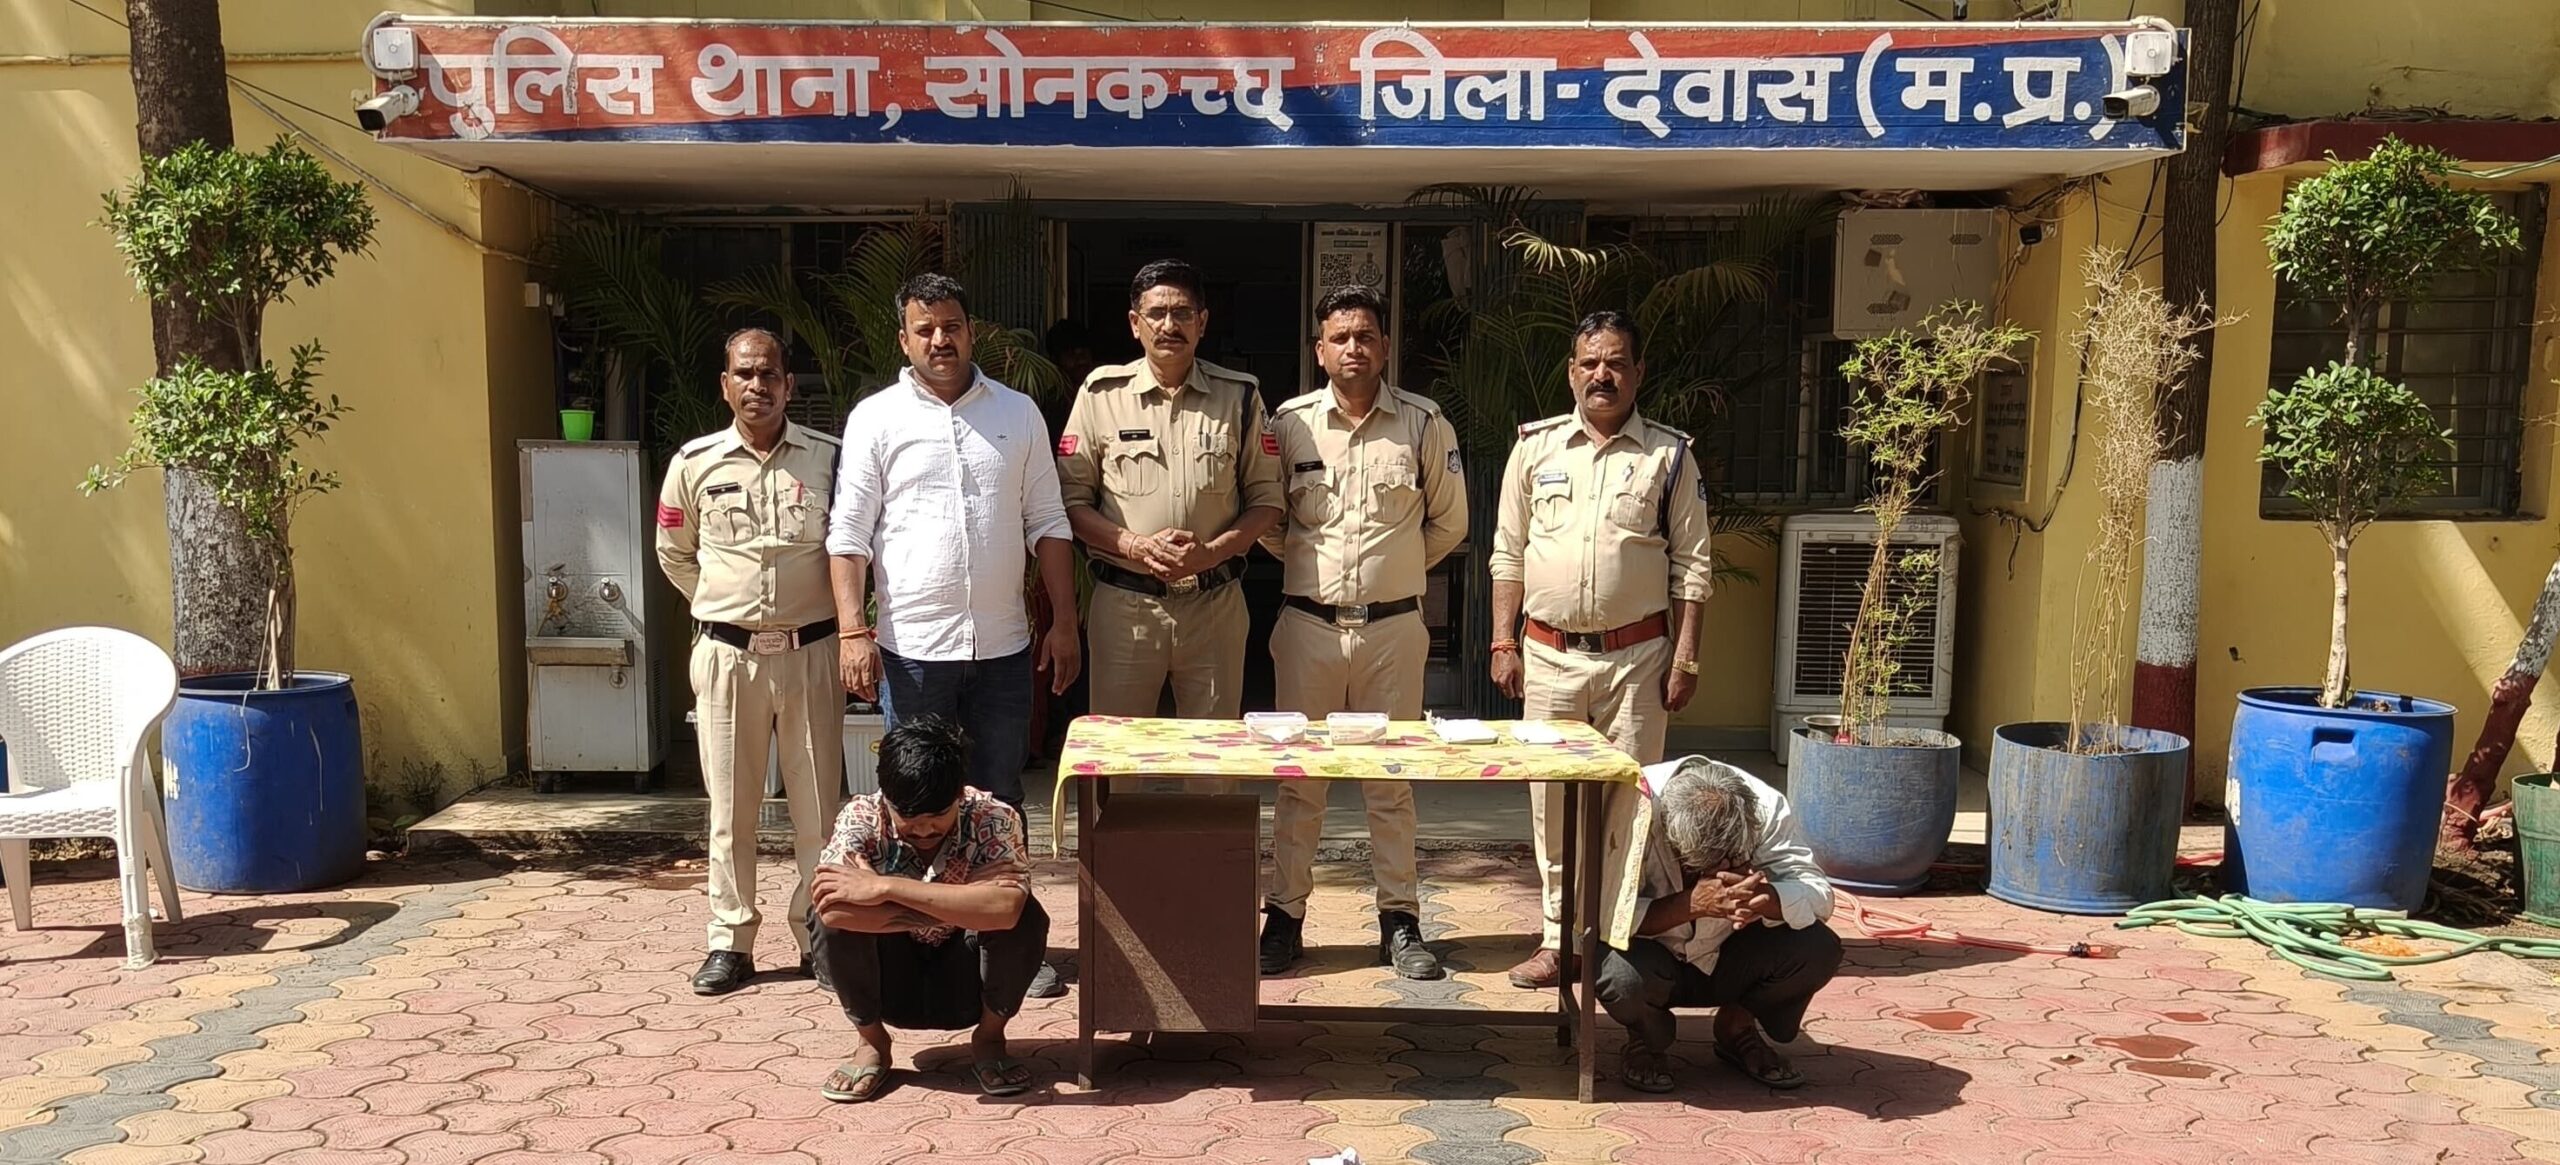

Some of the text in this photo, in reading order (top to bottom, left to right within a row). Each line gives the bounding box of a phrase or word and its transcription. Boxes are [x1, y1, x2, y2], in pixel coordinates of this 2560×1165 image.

[419, 25, 664, 140] पुलिस
[691, 43, 902, 132] थाना,
[924, 28, 1296, 132] सोनकच्छ
[1602, 31, 1844, 139] देवास
